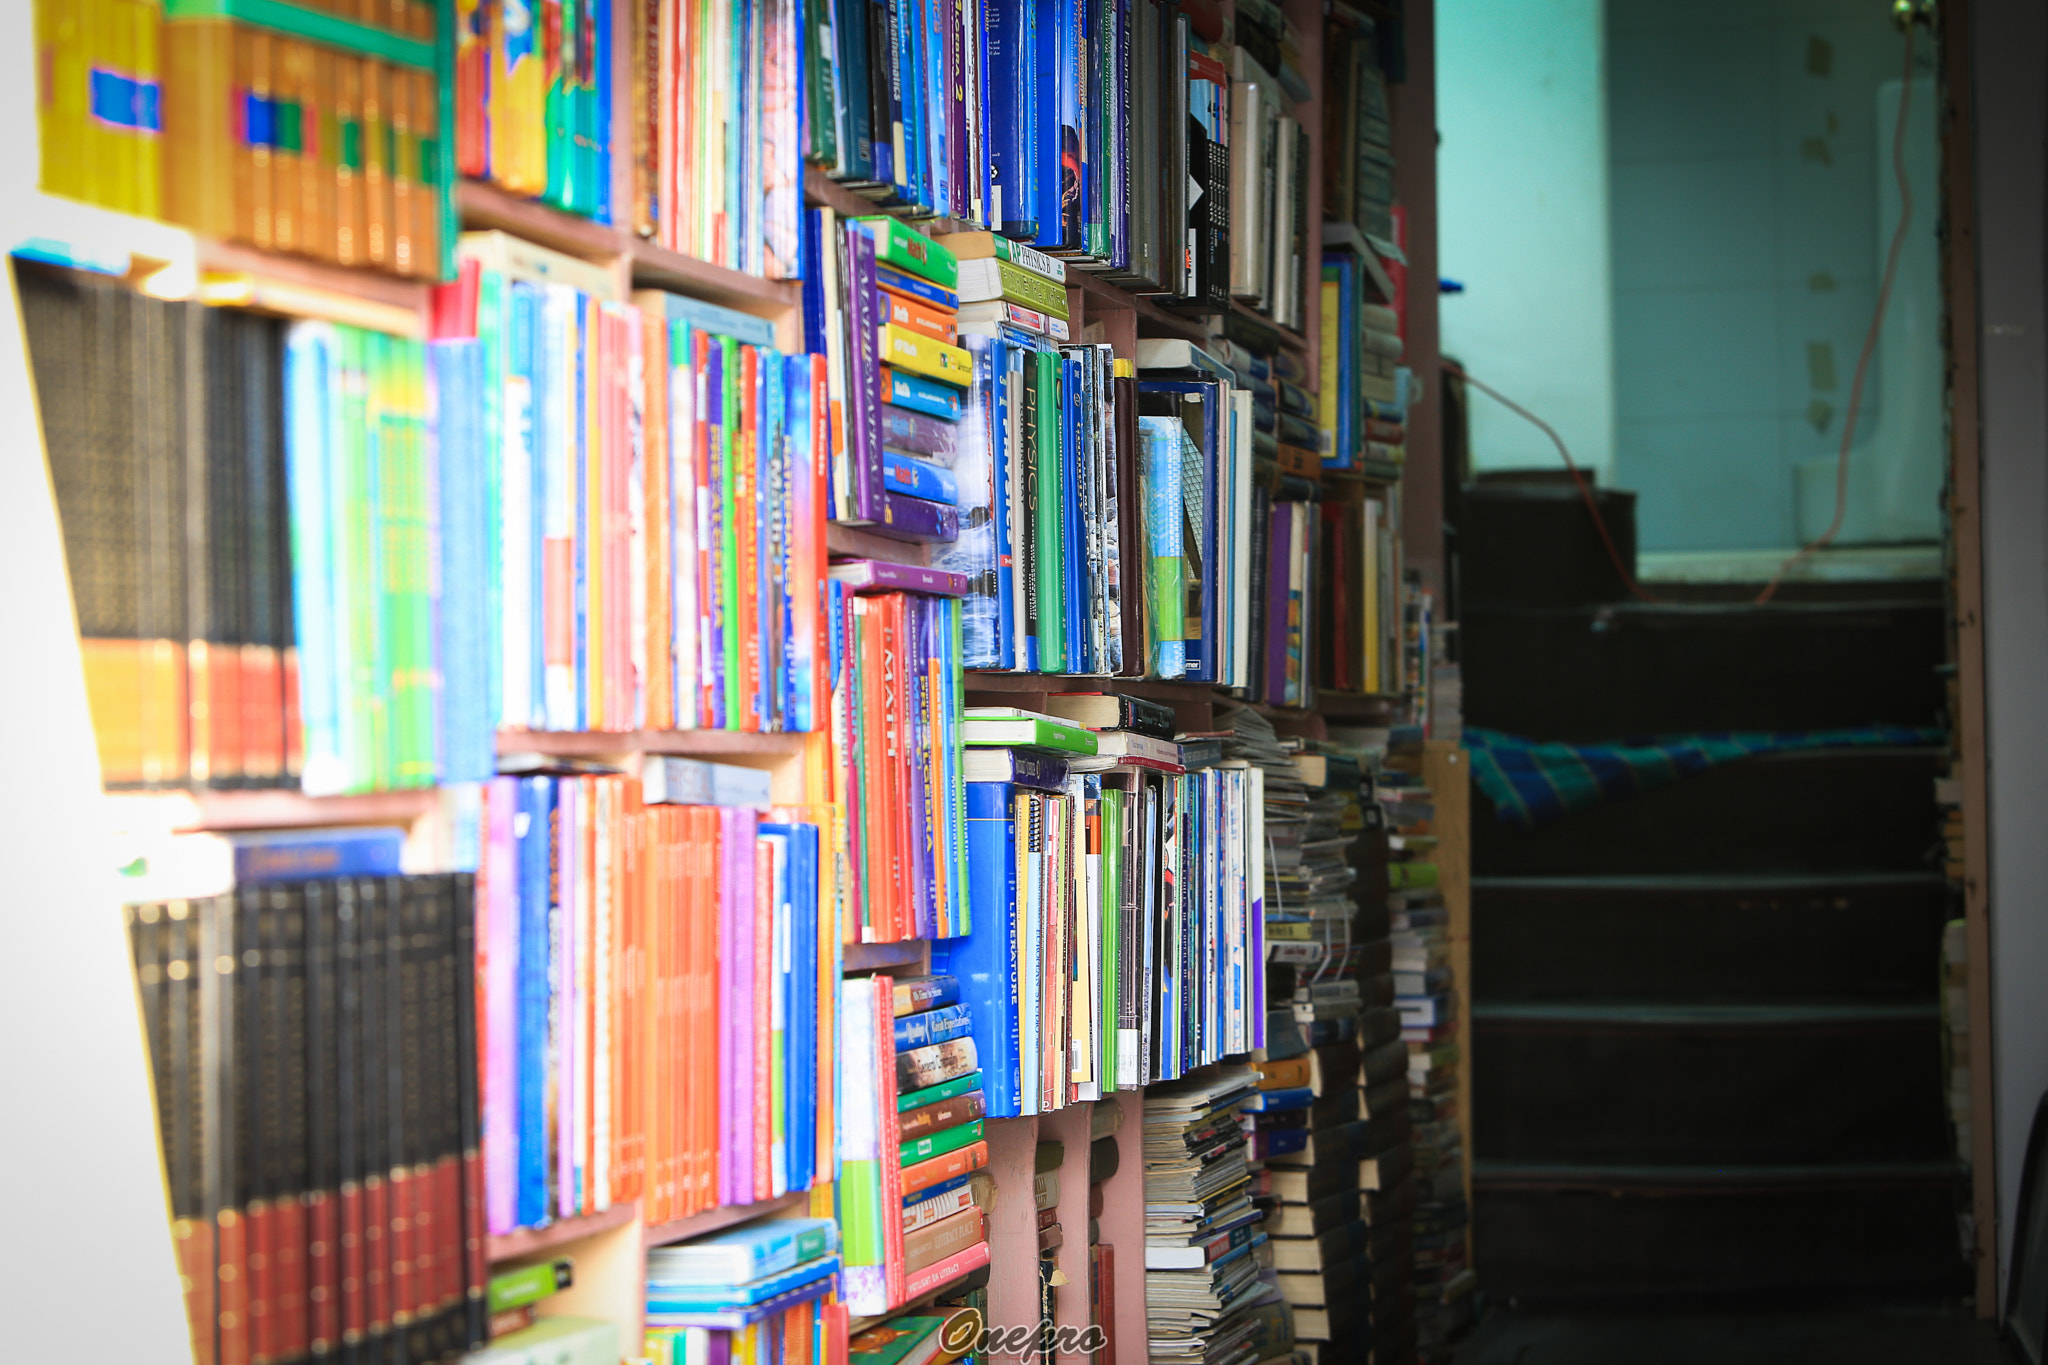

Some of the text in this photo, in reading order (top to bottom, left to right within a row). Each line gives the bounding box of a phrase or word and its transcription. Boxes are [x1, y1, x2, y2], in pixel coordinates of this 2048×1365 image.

[890, 15, 901, 101] Mathematics
[955, 83, 963, 102] 2
[1012, 241, 1021, 263] AP
[1021, 246, 1046, 273] PHYSICS
[1046, 257, 1050, 274] B
[1003, 418, 1012, 545] PHYSICS
[1026, 386, 1038, 512] PHYSICS
[746, 429, 756, 596] MATHEMATICS
[783, 434, 792, 598] MATHEMATICS
[884, 649, 896, 758] MATH
[913, 675, 922, 743] Math
[920, 674, 933, 853] PRE-ALGEBRA
[1009, 902, 1017, 1006] LITERATURE
[932, 1020, 943, 1033] Great
[943, 1015, 969, 1033] Expectations
[932, 1273, 939, 1282] ON
[939, 1263, 960, 1279] LITERACY
[935, 1226, 959, 1249] LITERACY
[959, 1220, 974, 1238] PLACE
